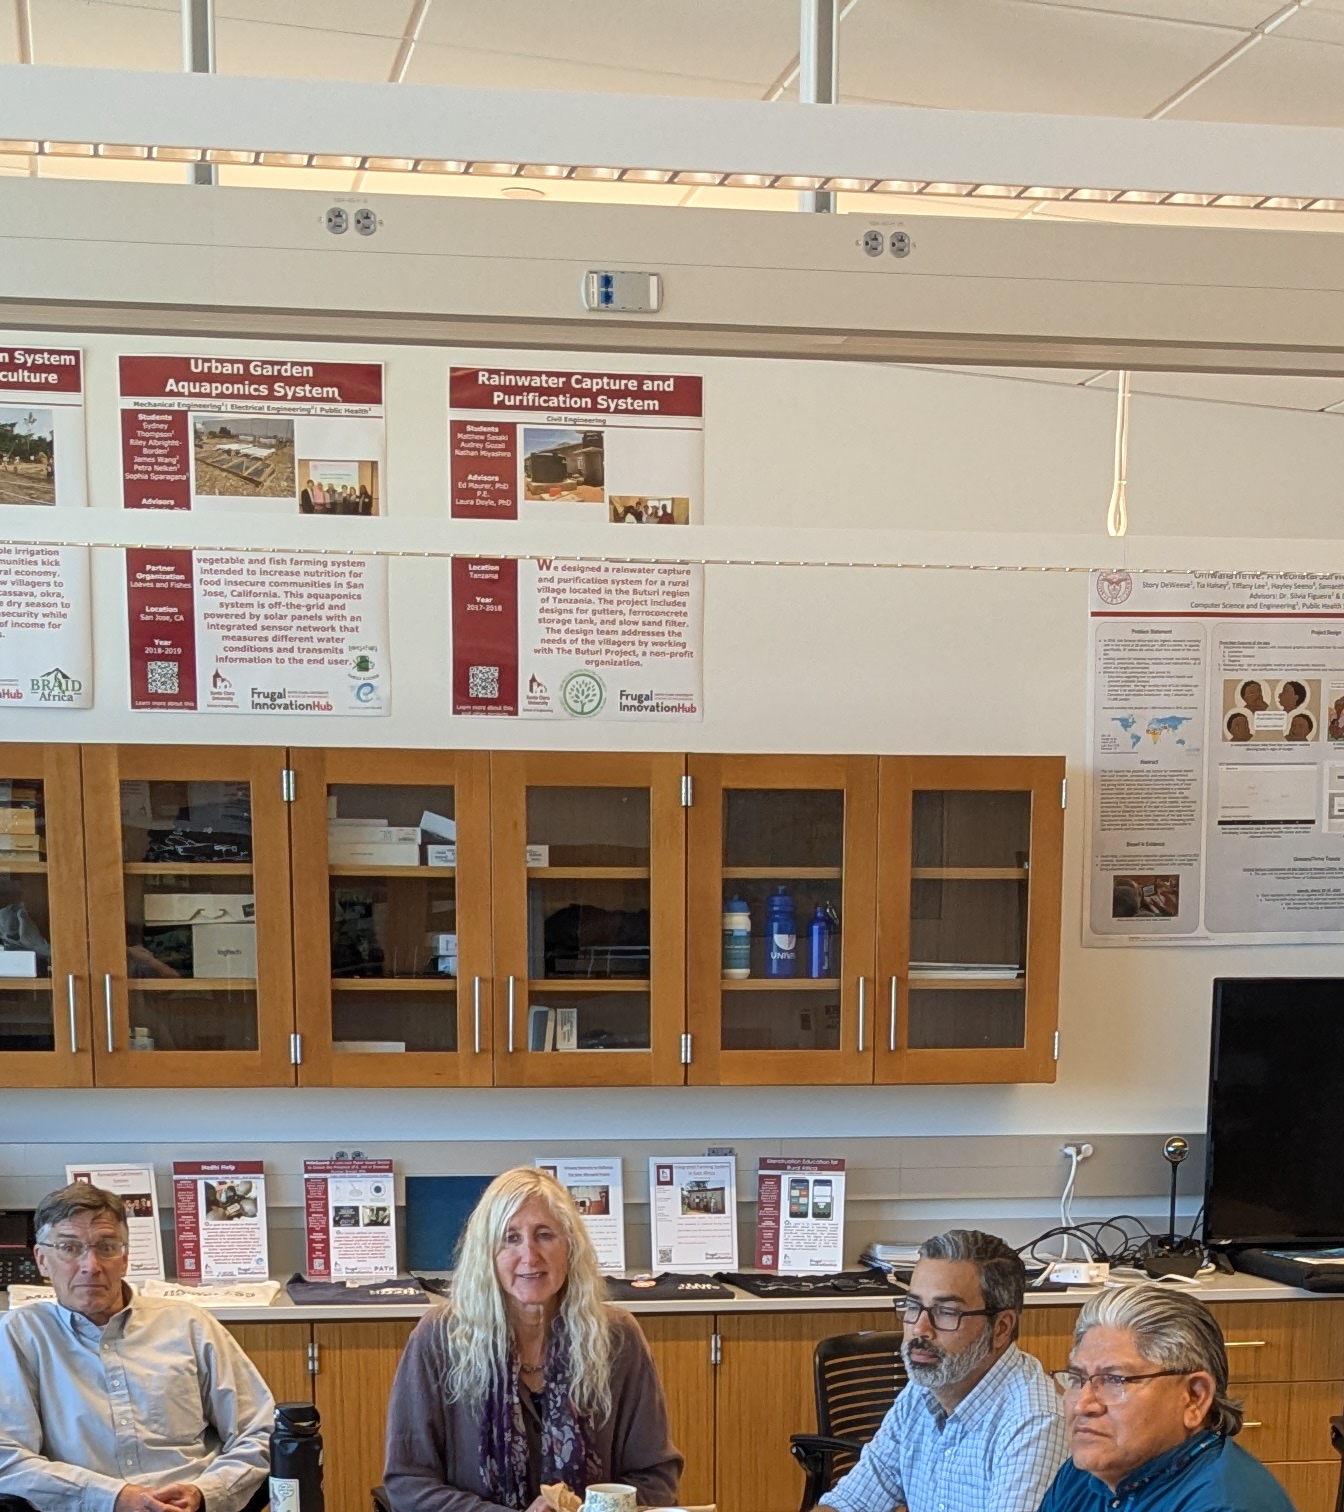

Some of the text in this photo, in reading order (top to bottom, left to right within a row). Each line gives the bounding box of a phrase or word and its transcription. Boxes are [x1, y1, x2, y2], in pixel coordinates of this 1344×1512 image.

[14, 350, 75, 368] System
[190, 359, 313, 377] Urban Garden
[478, 372, 674, 393] Rainwater Capture and
[165, 378, 339, 400] Aquaponics System
[493, 393, 659, 413] Purification System
[564, 417, 606, 425] Engineering
[15, 548, 59, 556] irrigation
[15, 569, 60, 578] economy.
[146, 564, 175, 572] Partner
[136, 573, 185, 581] Organization
[202, 590, 361, 601] Jose, California. This aquaponics
[42, 611, 67, 619] while
[539, 607, 573, 616] designs
[592, 608, 625, 618] gutters,
[628, 609, 688, 618] ferroconcrete
[207, 622, 359, 633] integrated sensor network that
[222, 634, 268, 642] measures
[272, 634, 314, 643] different
[298, 646, 344, 654] transmits
[585, 659, 642, 667] organization.
[30, 679, 82, 691] BRAID
[39, 691, 73, 702] Africa
[251, 688, 286, 701] Frugal
[620, 690, 653, 704] Frugal
[252, 700, 332, 711] InnovationHub
[620, 703, 696, 713] InnovationHub
